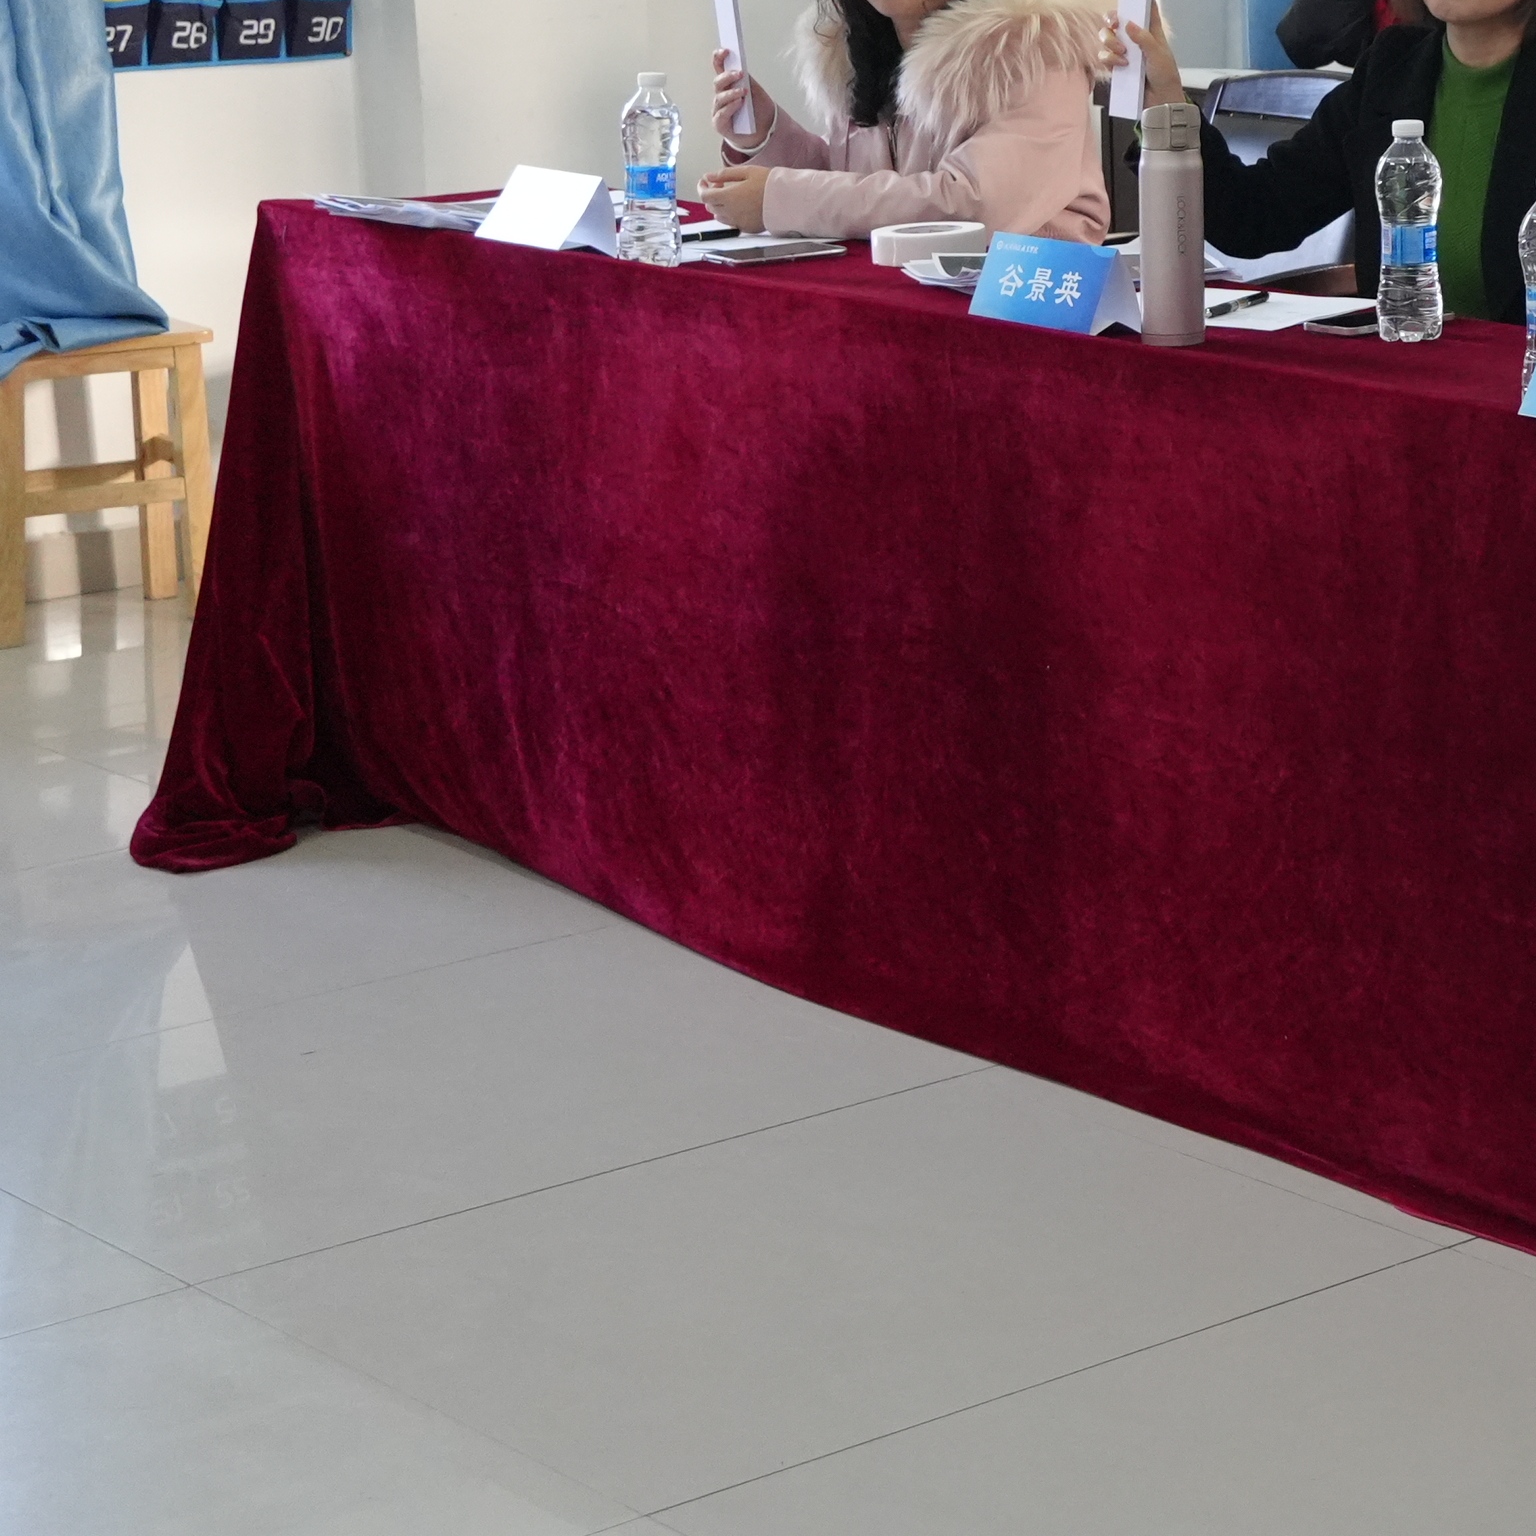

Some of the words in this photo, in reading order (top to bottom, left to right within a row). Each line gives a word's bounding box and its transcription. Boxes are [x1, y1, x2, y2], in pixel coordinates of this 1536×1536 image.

[172, 21, 207, 48] 28
[240, 19, 275, 44] 29
[308, 17, 343, 42] 30
[998, 264, 1082, 307] 谷景英
